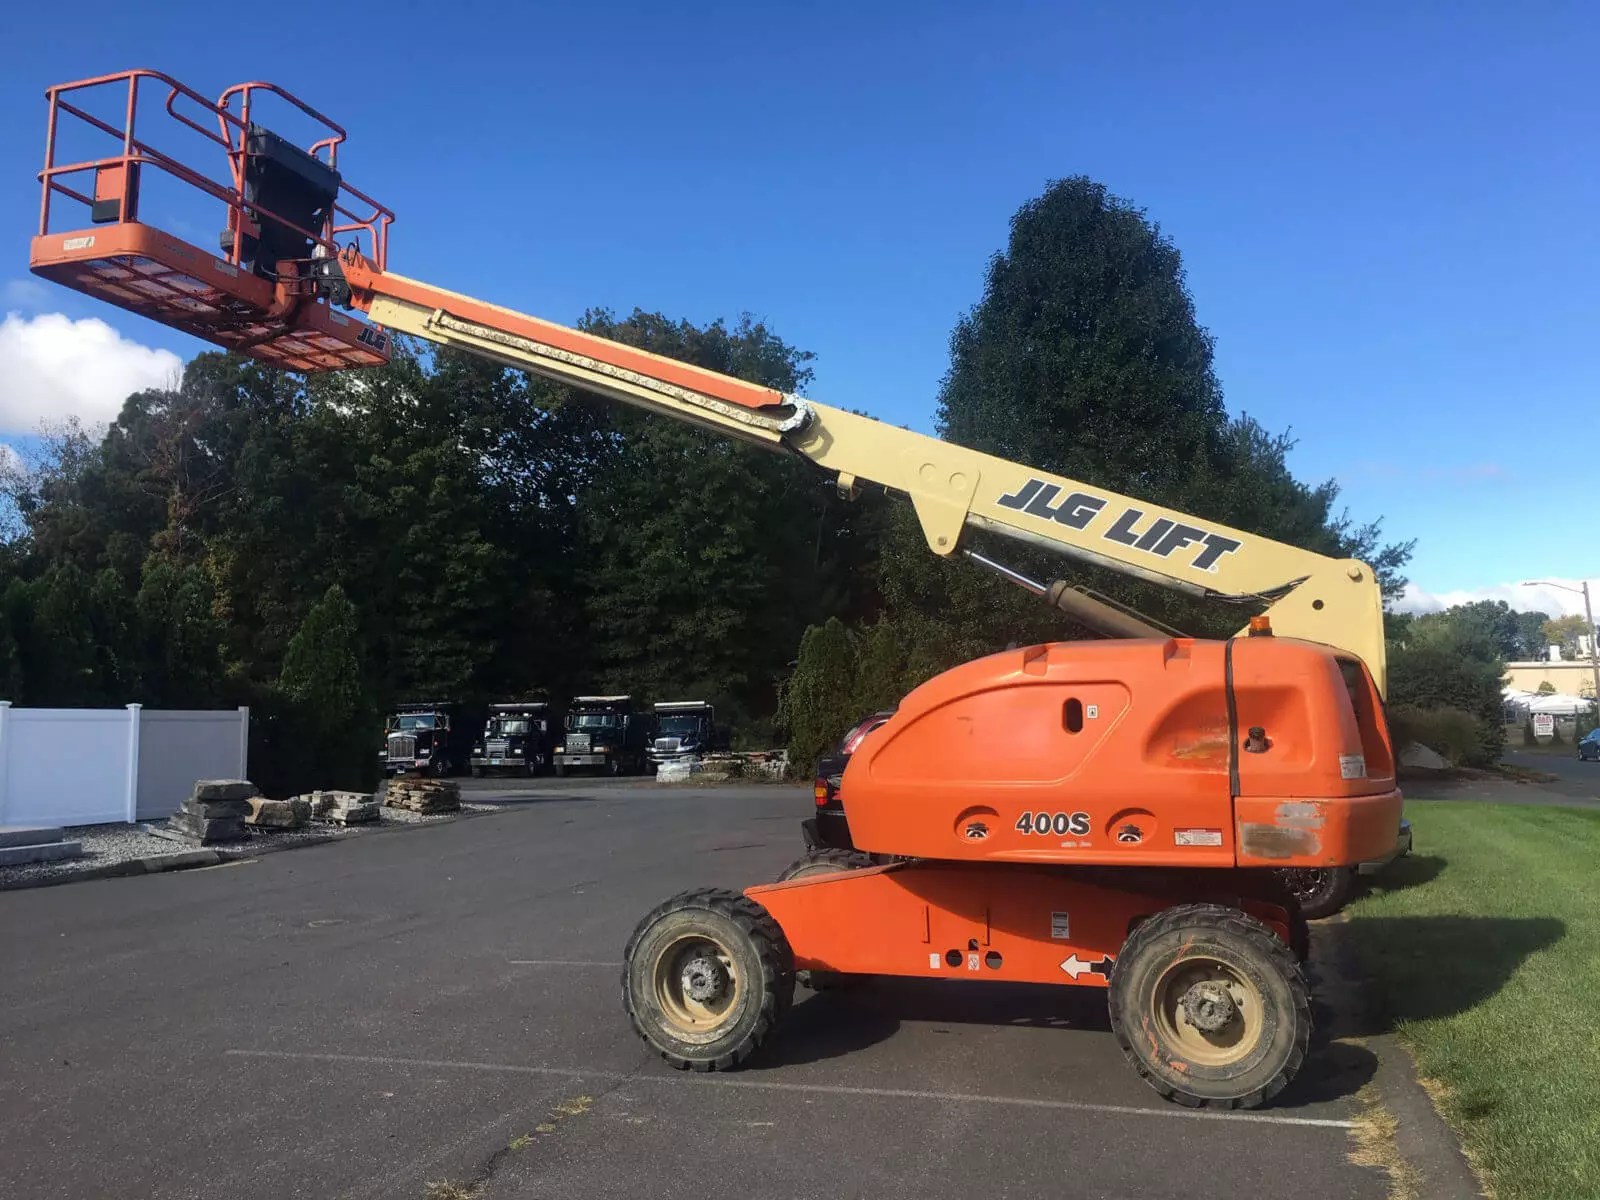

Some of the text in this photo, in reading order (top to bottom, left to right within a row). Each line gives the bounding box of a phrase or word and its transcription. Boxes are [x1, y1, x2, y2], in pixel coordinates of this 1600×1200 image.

[356, 328, 387, 351] JLG
[997, 478, 1242, 570] JLG LIFT
[1015, 812, 1090, 836] 400S
